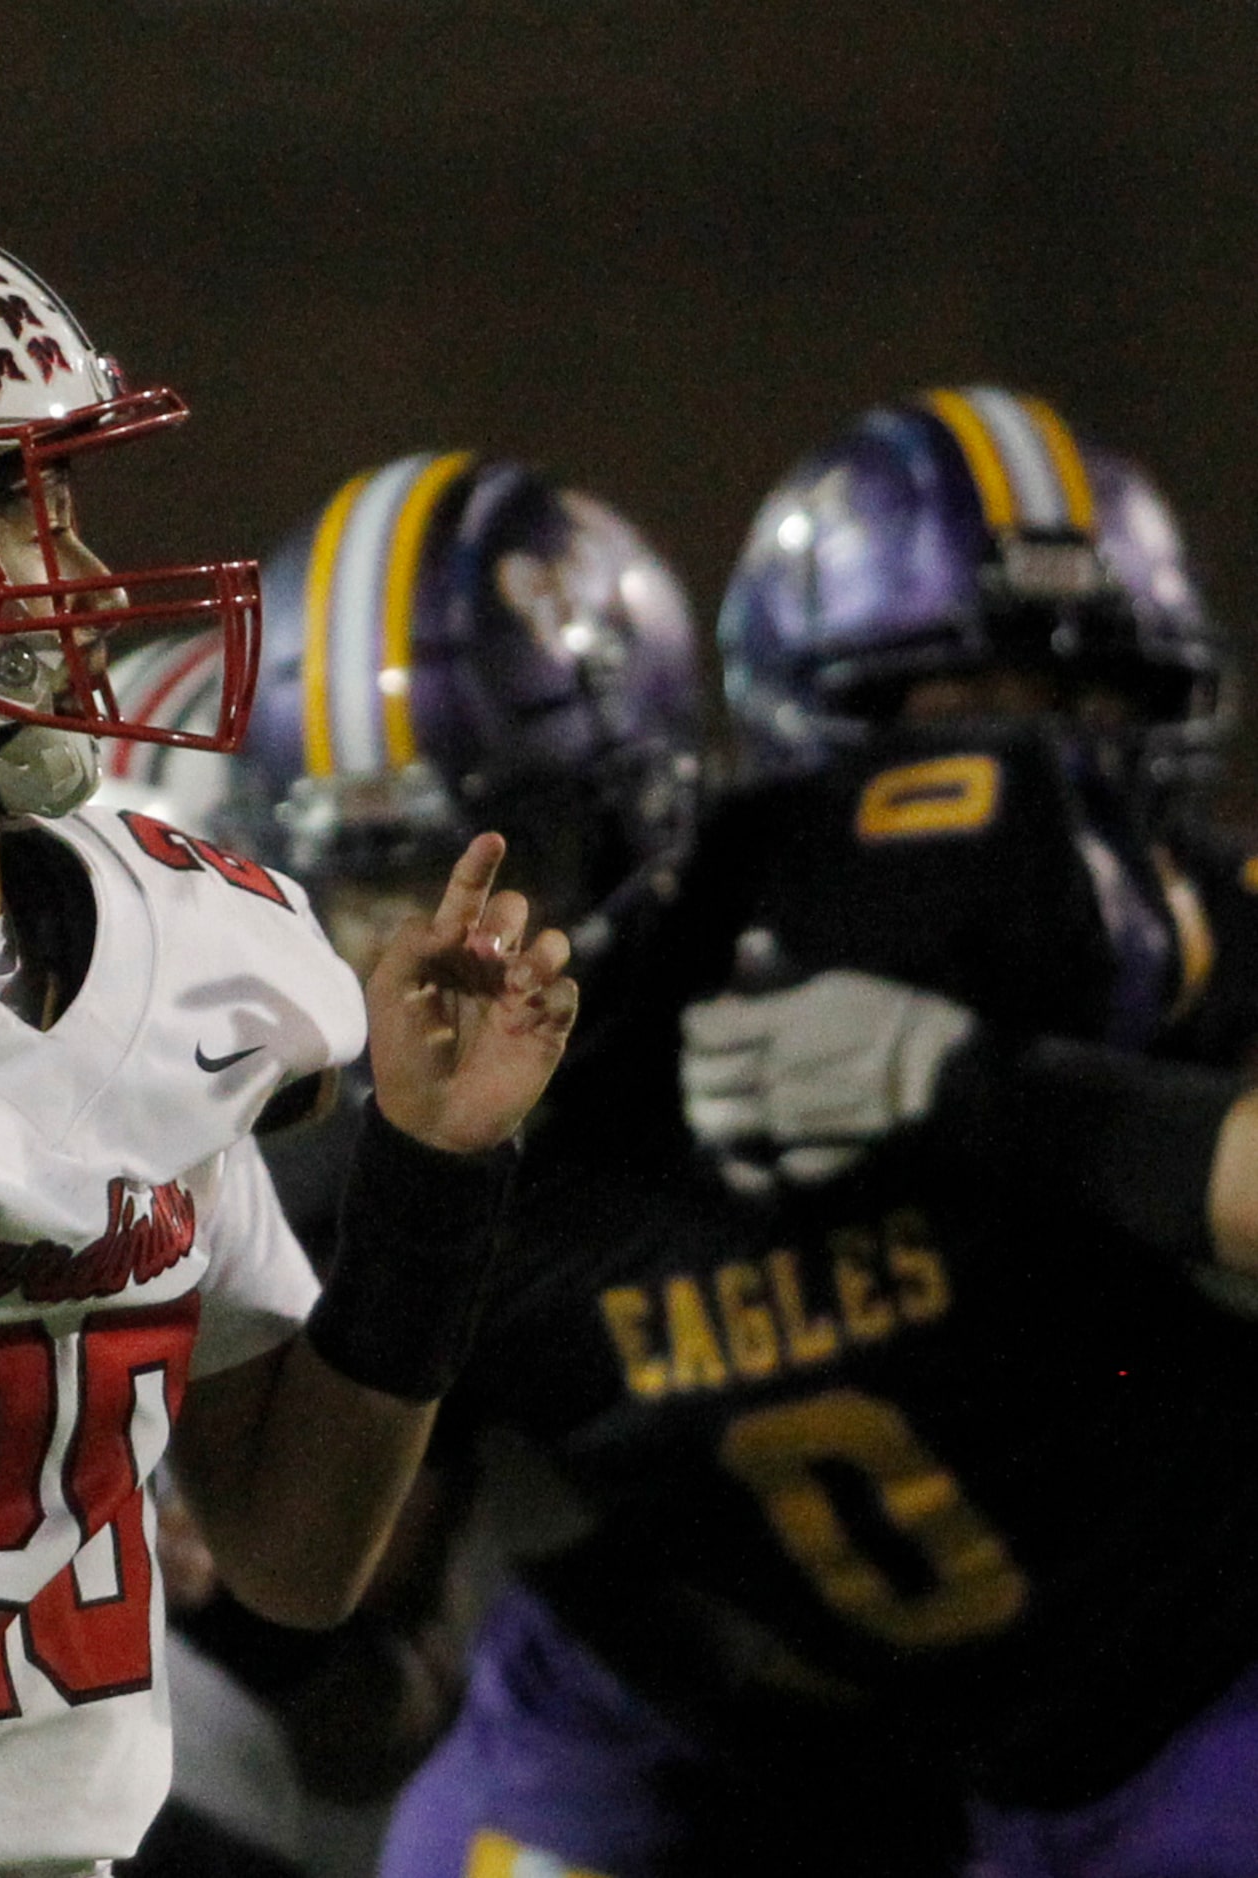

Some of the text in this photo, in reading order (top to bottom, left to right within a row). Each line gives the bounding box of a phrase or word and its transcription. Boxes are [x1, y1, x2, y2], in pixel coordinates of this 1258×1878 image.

[857, 755, 1000, 845] 0
[598, 1210, 951, 1396] EAGLES
[720, 1391, 1026, 1645] 0
